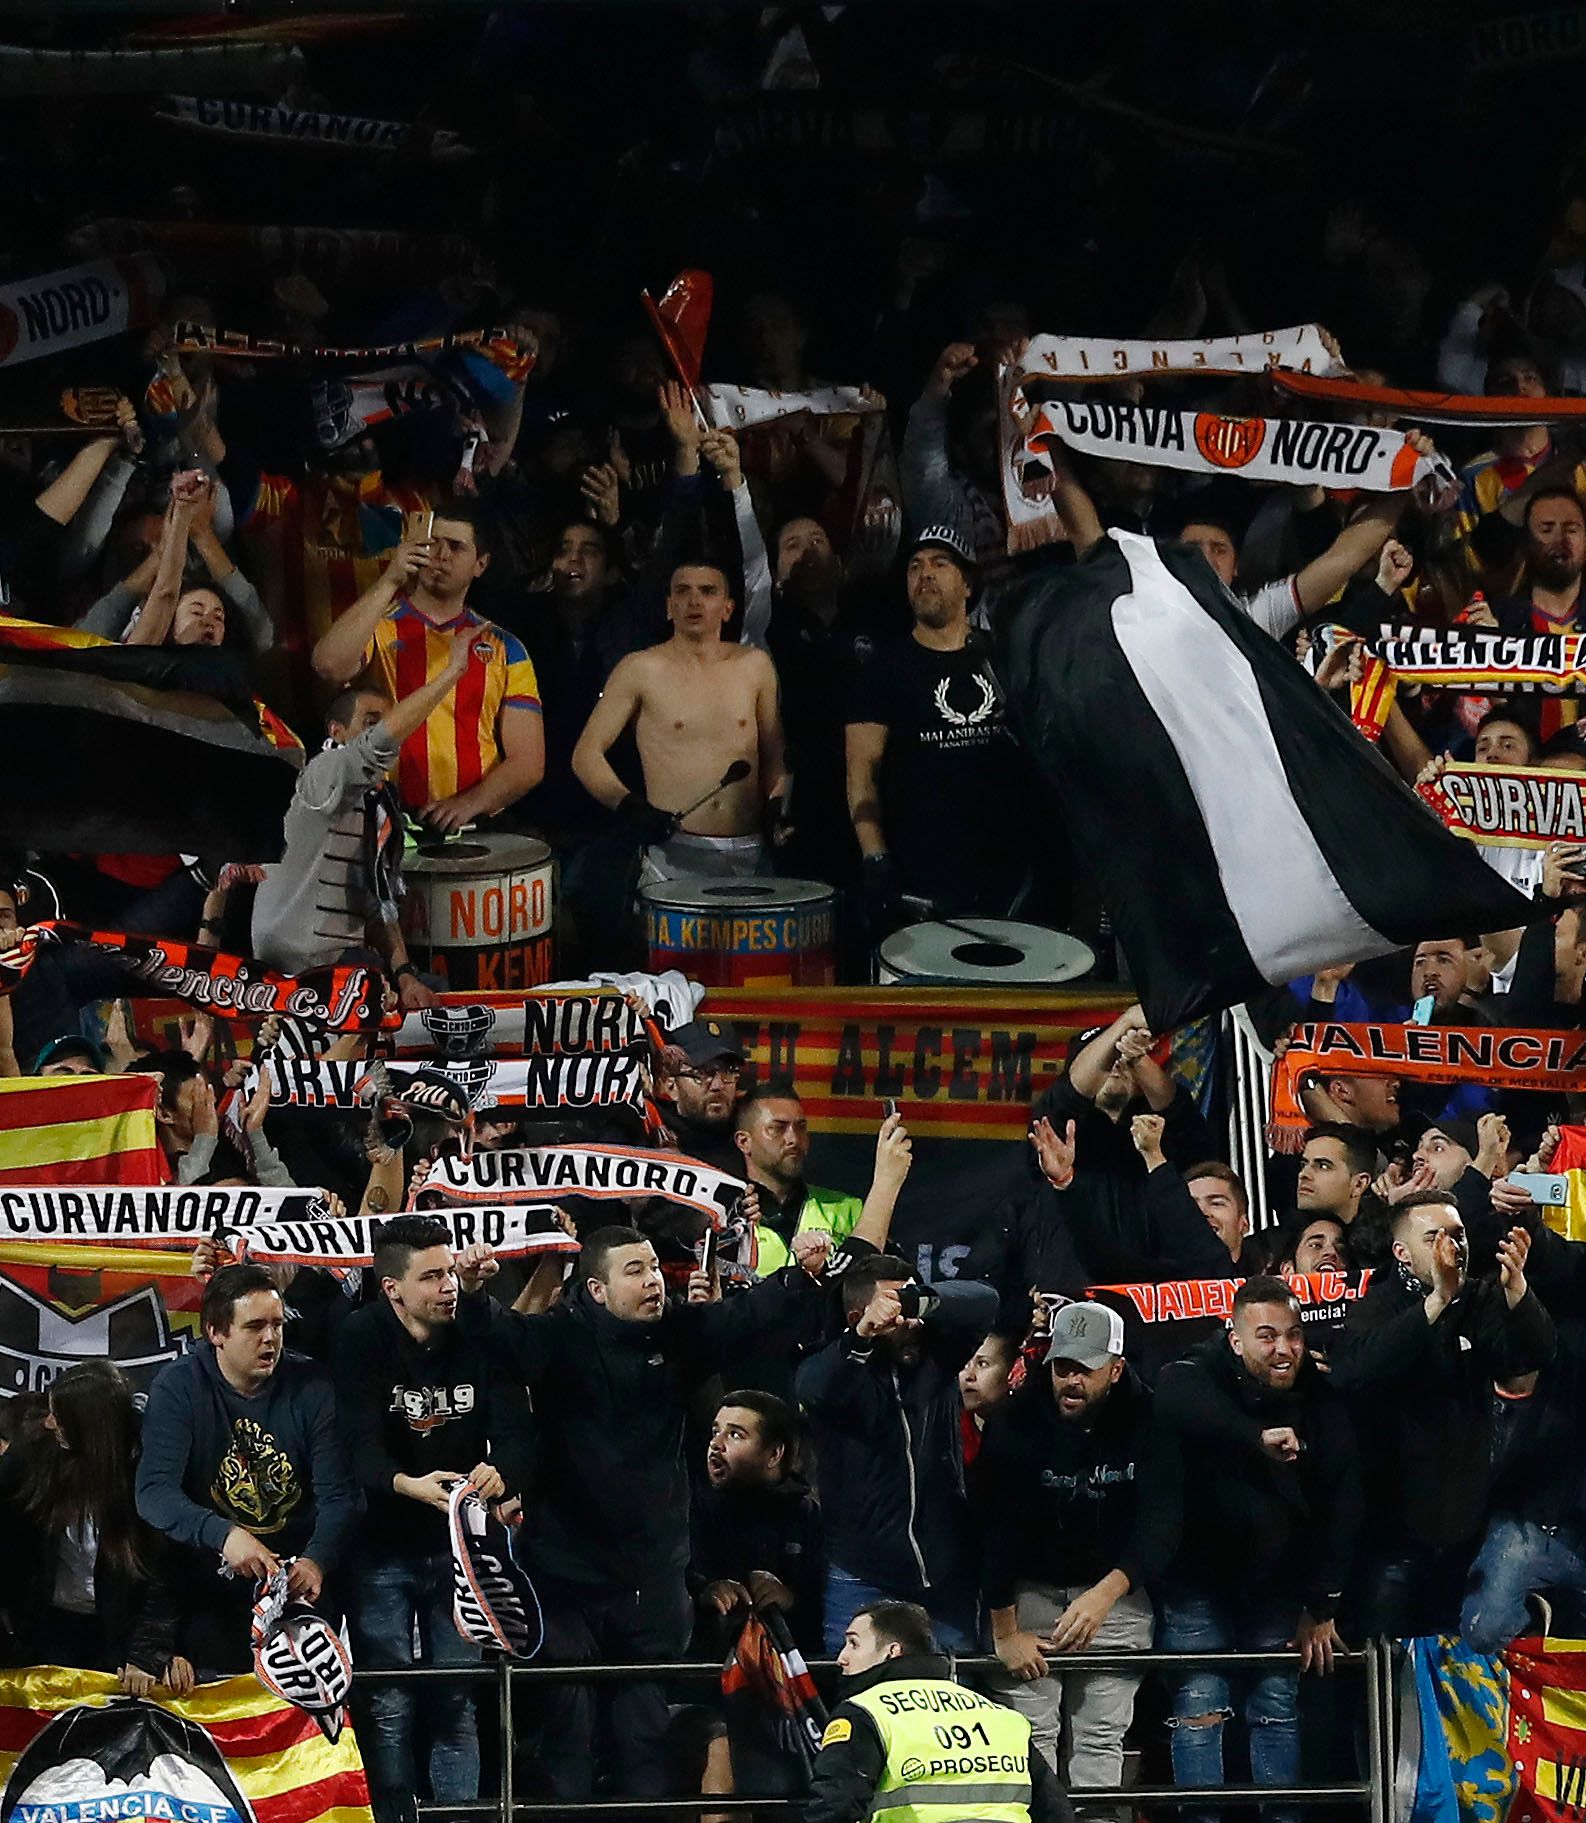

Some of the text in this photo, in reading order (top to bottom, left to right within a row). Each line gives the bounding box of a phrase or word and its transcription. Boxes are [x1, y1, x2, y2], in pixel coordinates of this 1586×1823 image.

[1065, 401, 1381, 474] CURVA NORD
[1441, 772, 1586, 838] CURVA
[448, 878, 546, 939] NORD
[680, 916, 779, 951] KEMPES
[443, 1151, 699, 1197] CURVANORD
[3, 1189, 261, 1234] CURVANORD
[879, 1688, 1006, 1716] SEGURIDA
[934, 1722, 991, 1750] 091
[929, 1754, 1030, 1777] PROSEGU
[20, 1794, 176, 1823] VALENCIA
